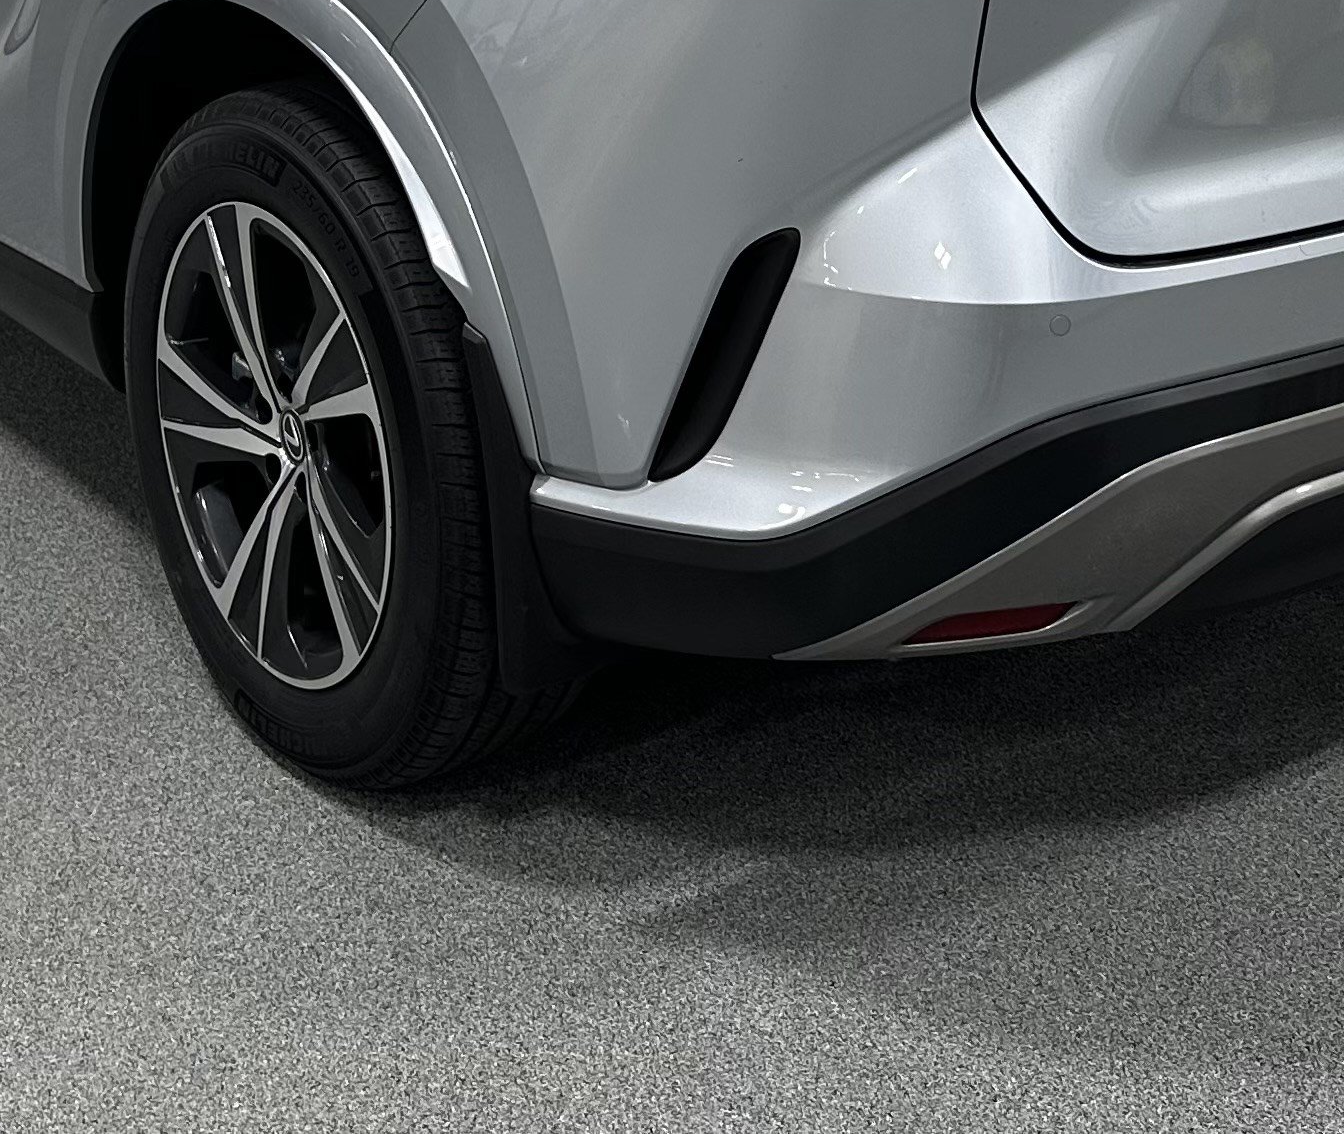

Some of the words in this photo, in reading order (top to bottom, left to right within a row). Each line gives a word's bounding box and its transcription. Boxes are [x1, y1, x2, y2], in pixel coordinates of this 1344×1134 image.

[291, 179, 337, 235] 235/60
[334, 237, 348, 253] R
[345, 257, 360, 278] 19
